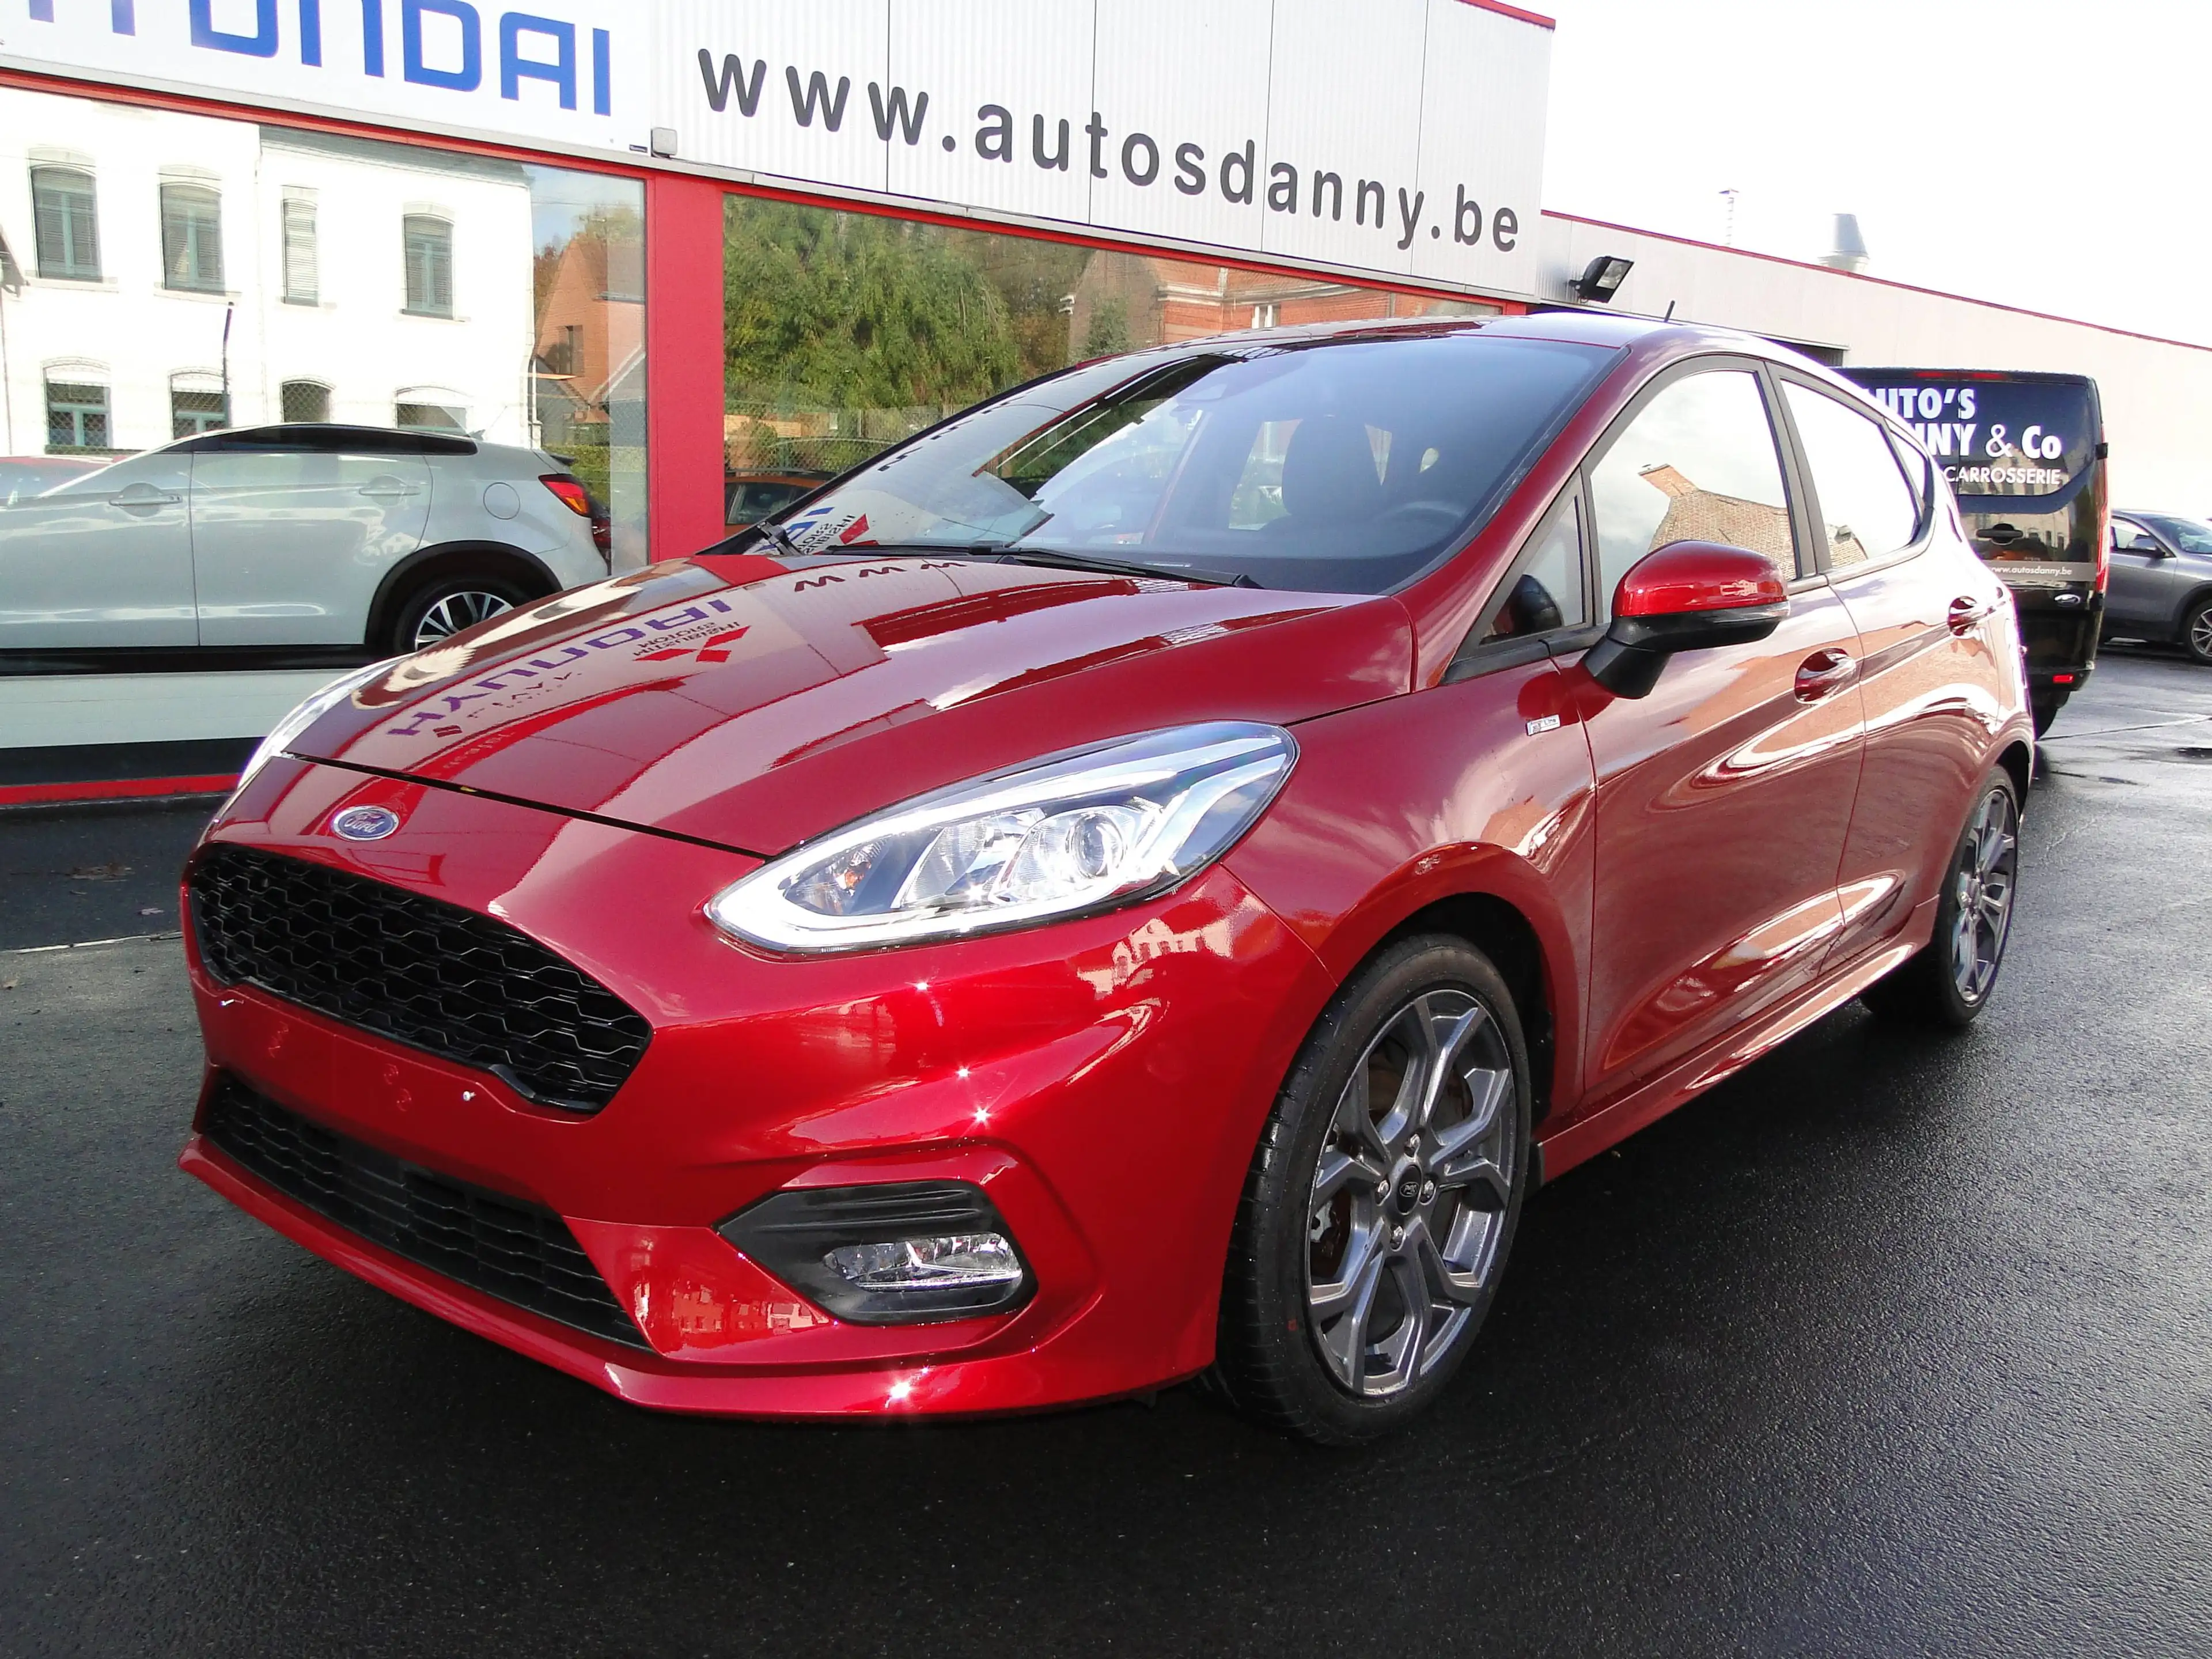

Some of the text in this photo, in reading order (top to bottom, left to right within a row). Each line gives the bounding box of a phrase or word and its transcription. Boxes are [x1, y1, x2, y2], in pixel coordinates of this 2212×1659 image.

[30, 0, 611, 116] UNDAI
[697, 48, 1520, 251] www.autosdanny.be
[1866, 388, 1975, 419] UTO'S
[1986, 424, 2014, 458] &
[2021, 425, 2062, 460] Co
[1944, 466, 2061, 485] CARROSSERIE
[1990, 566, 2073, 576] ww.autosdanny.be
[344, 811, 385, 834] Ford
